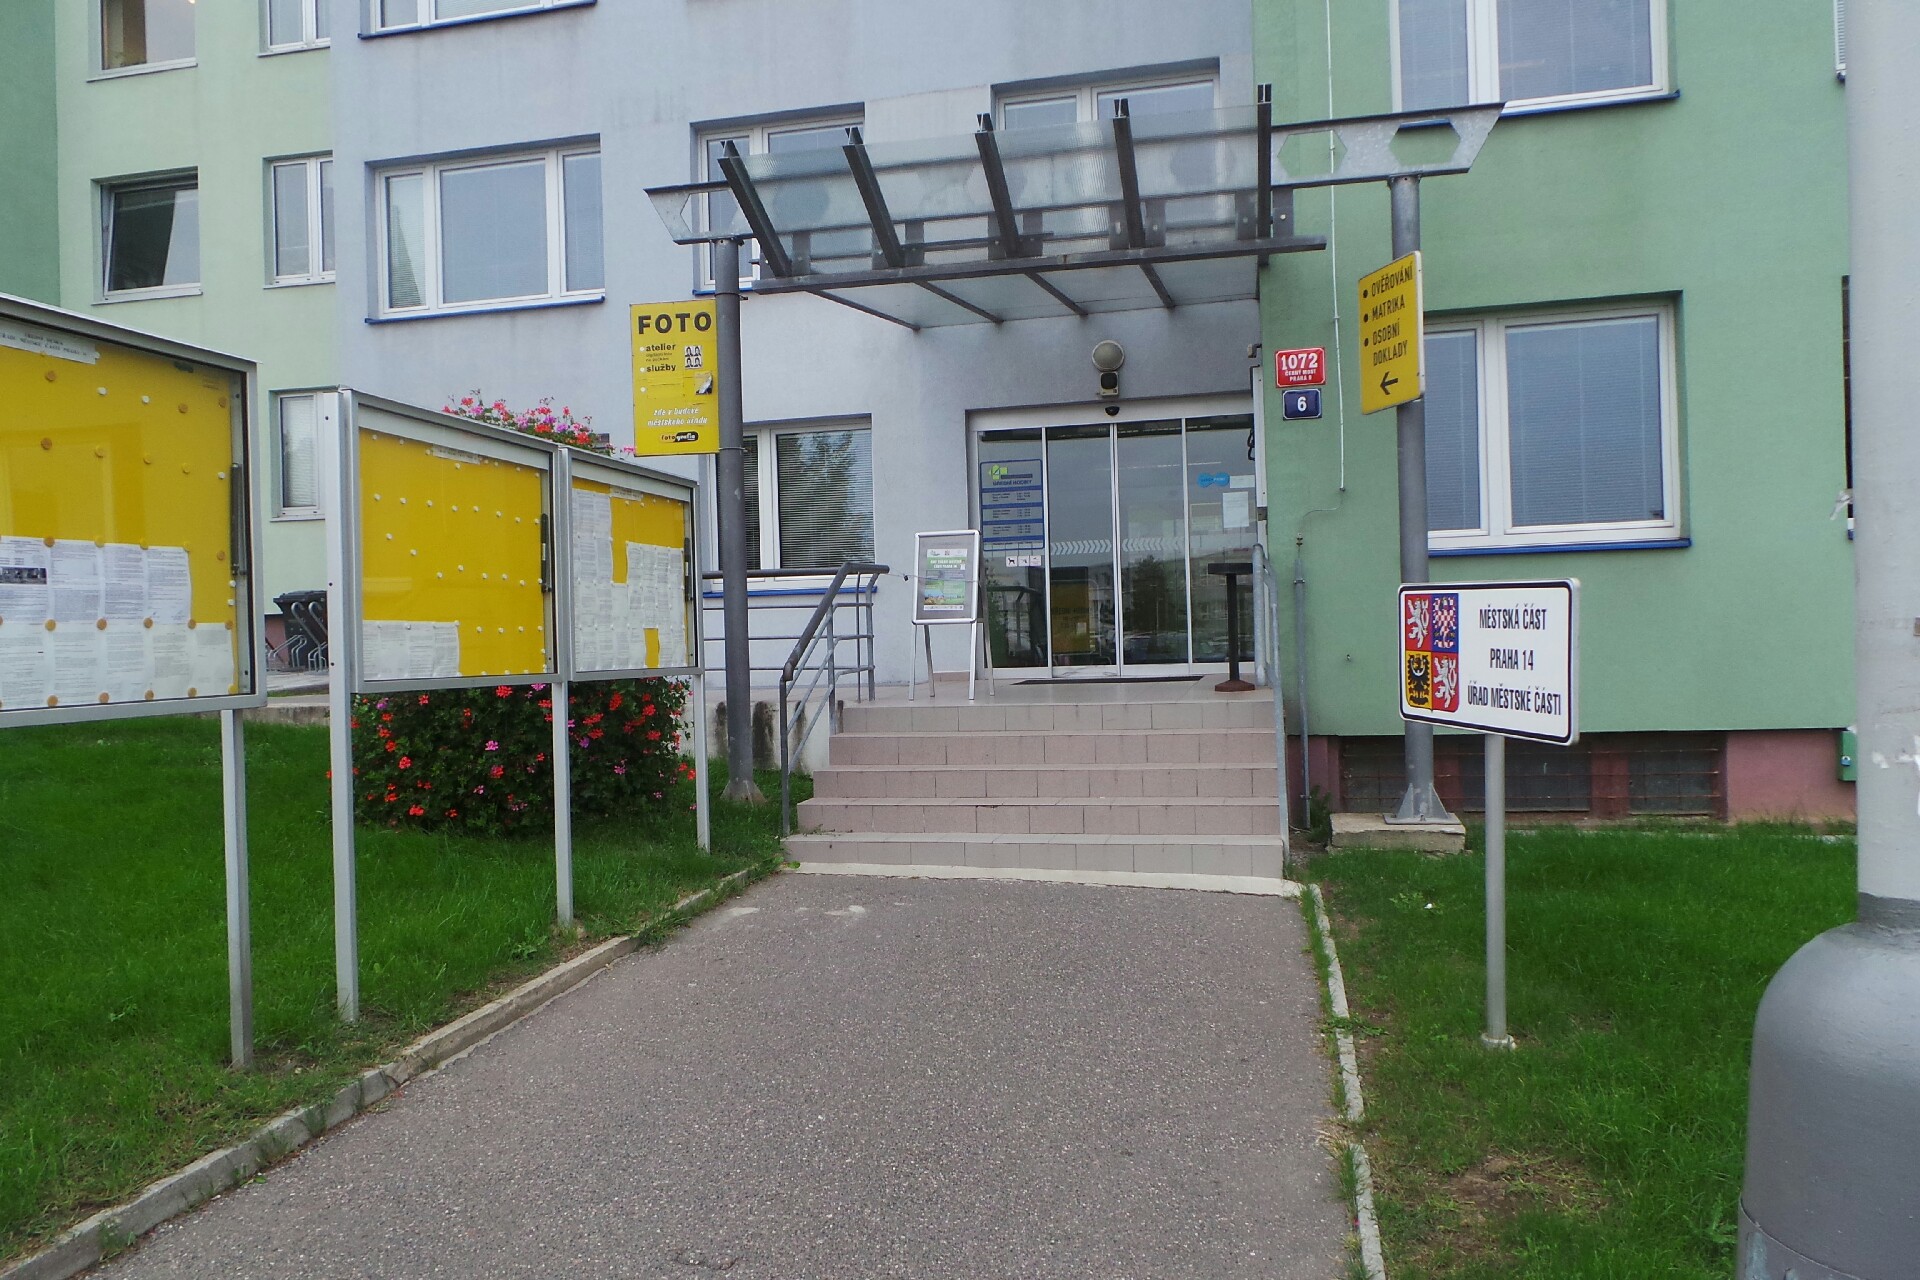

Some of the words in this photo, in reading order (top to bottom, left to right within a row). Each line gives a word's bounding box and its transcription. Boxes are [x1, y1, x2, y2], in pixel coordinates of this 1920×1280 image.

[1372, 261, 1413, 296] OVĚŘOVÁNÍ
[1372, 294, 1405, 321] MATRIKA
[638, 312, 712, 334] FOTO
[1372, 317, 1400, 346] OSOBNÍ
[646, 343, 676, 352] atelier
[1373, 339, 1408, 366] DOKLADY
[646, 363, 676, 373] služby
[1281, 353, 1318, 370] 1072
[1297, 396, 1307, 411] 6
[1479, 603, 1520, 629] MĚSTSKÁ
[1522, 603, 1547, 630] ČÁST
[1489, 648, 1519, 670] PRAHA
[1522, 649, 1534, 671] 14
[1467, 680, 1488, 706] ÚŘAD
[1490, 683, 1531, 712] MĚSTSKÉ
[1534, 685, 1562, 716] ČÁSTI
